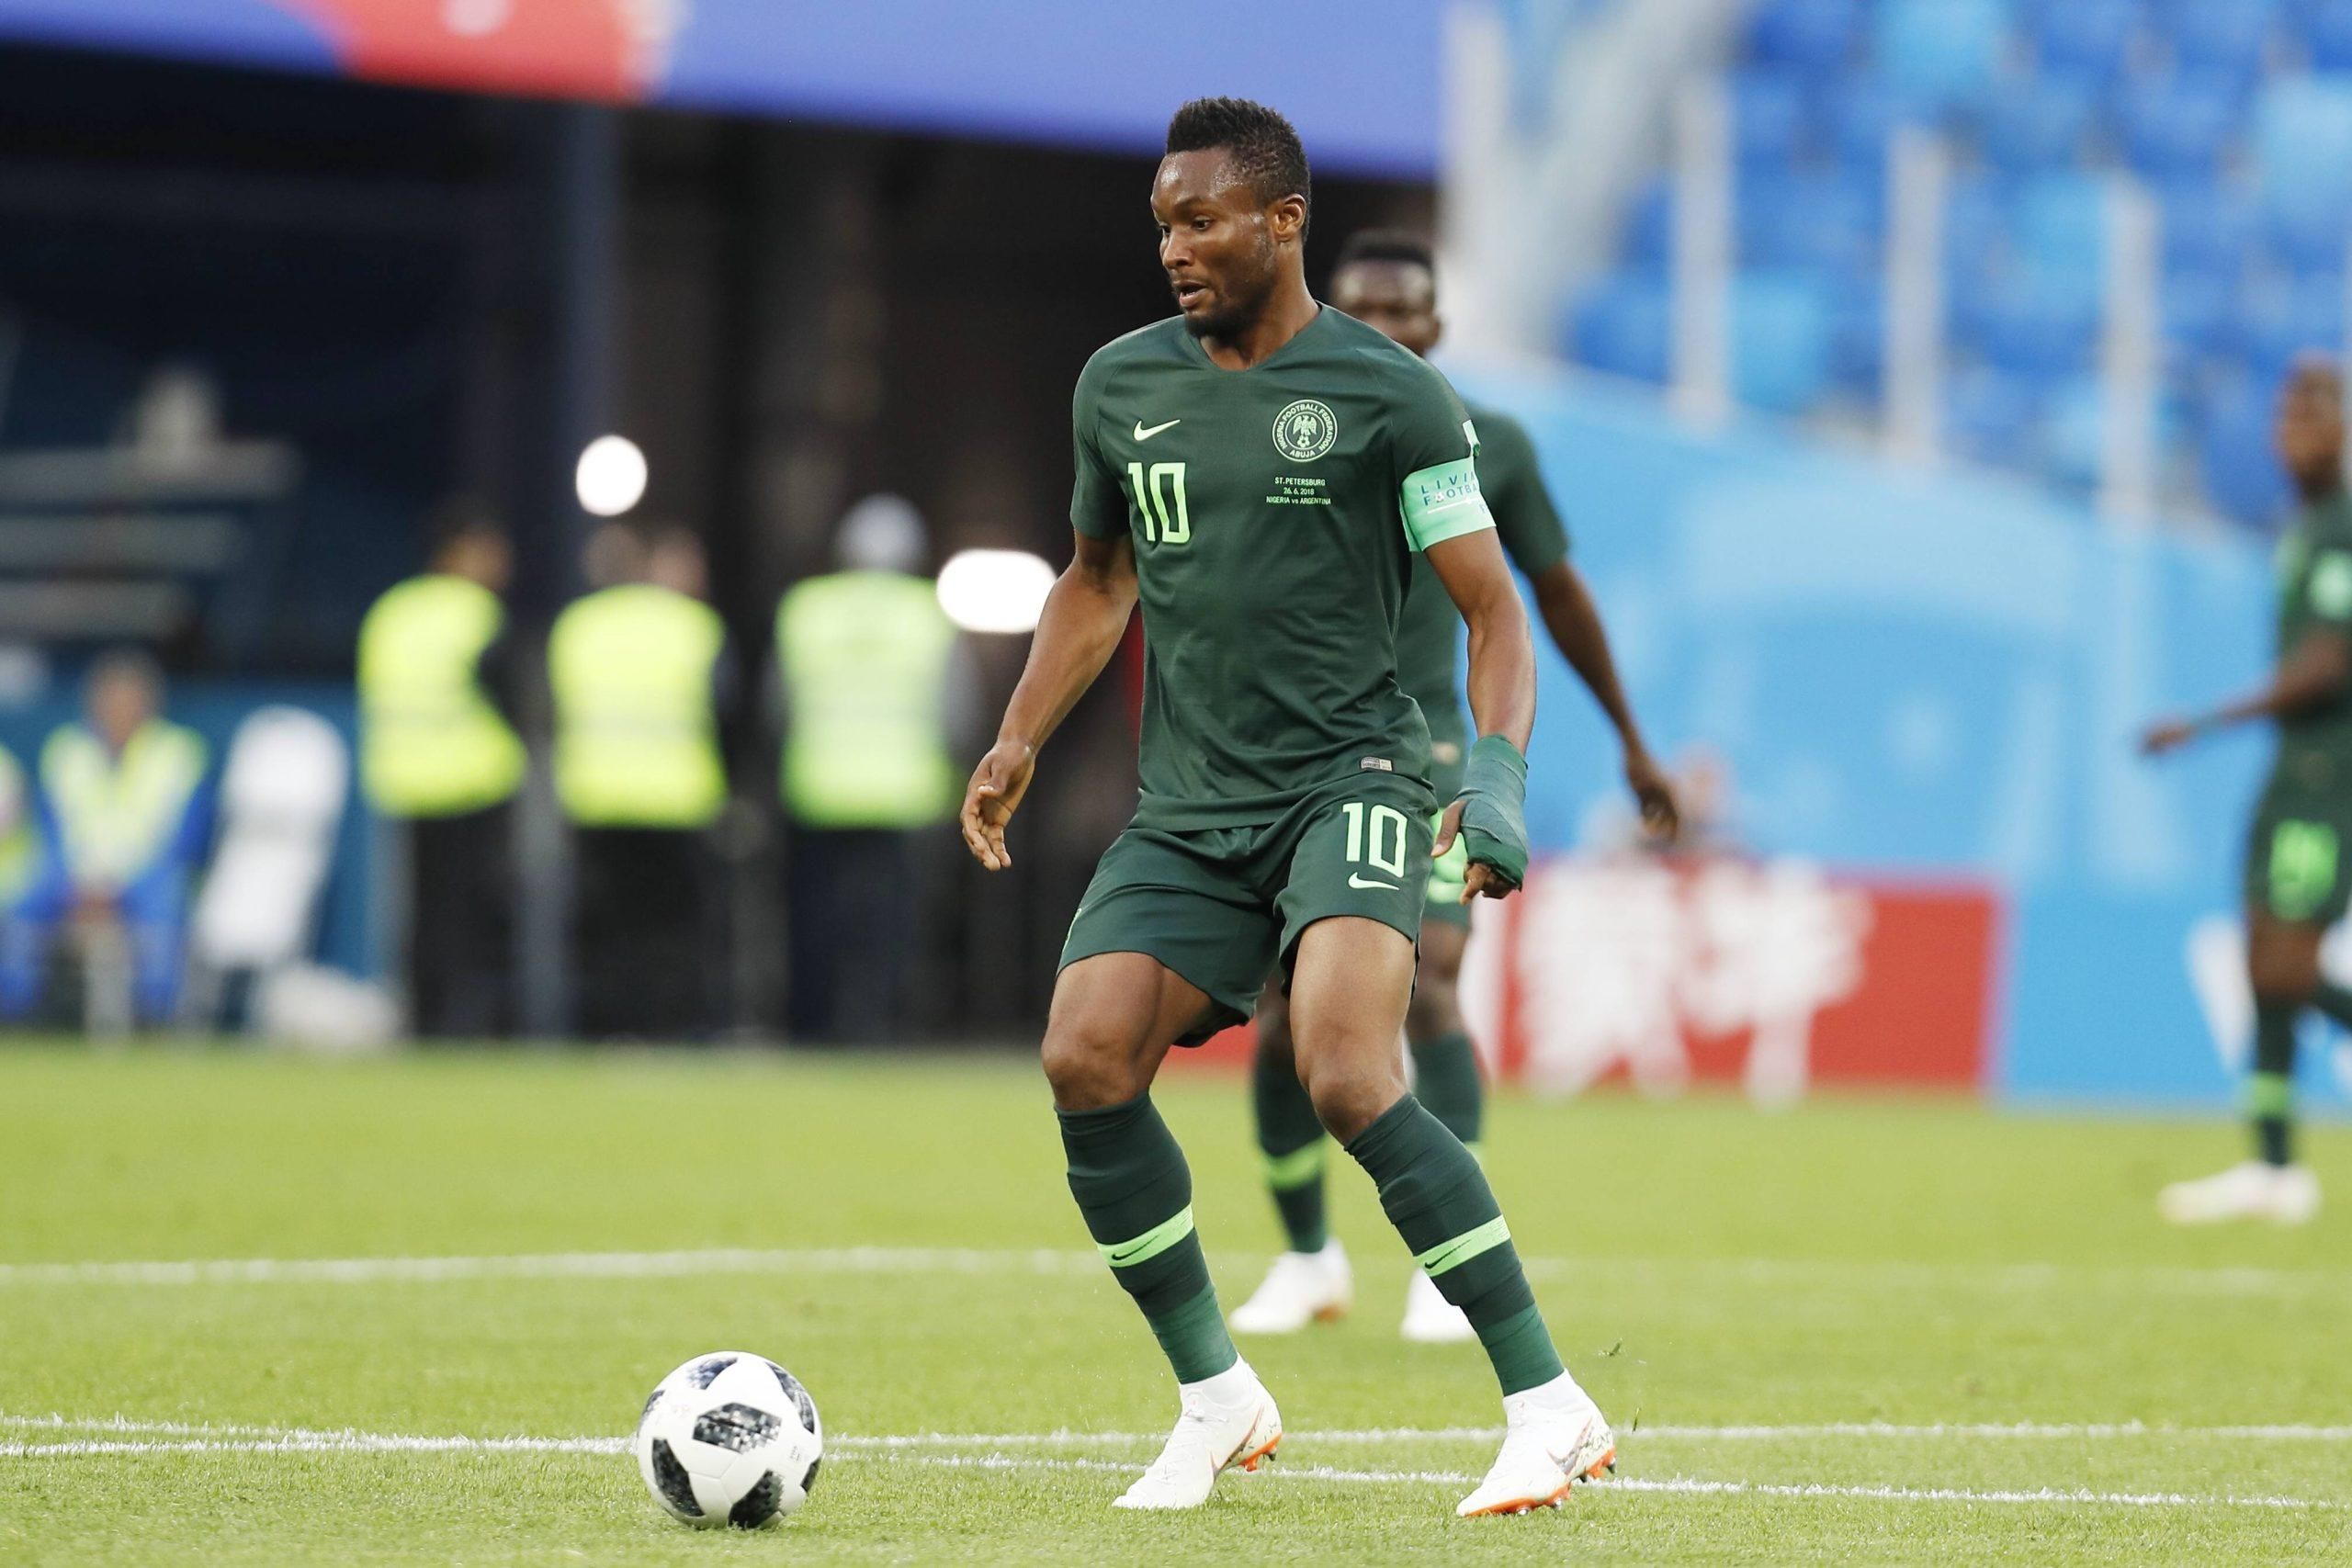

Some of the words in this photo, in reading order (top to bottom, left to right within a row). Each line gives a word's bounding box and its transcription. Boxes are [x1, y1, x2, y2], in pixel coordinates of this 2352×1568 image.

[1276, 421, 1288, 450] NIGERIA
[1282, 403, 1319, 422] FOOTBALL
[1317, 408, 1334, 452] FEDERATION
[1289, 449, 1316, 458] ABUJA
[1127, 462, 1191, 543] 10
[1266, 496, 1291, 504] NIGERIA
[1299, 497, 1331, 505] ARGENTINA
[1342, 802, 1408, 878] 10
